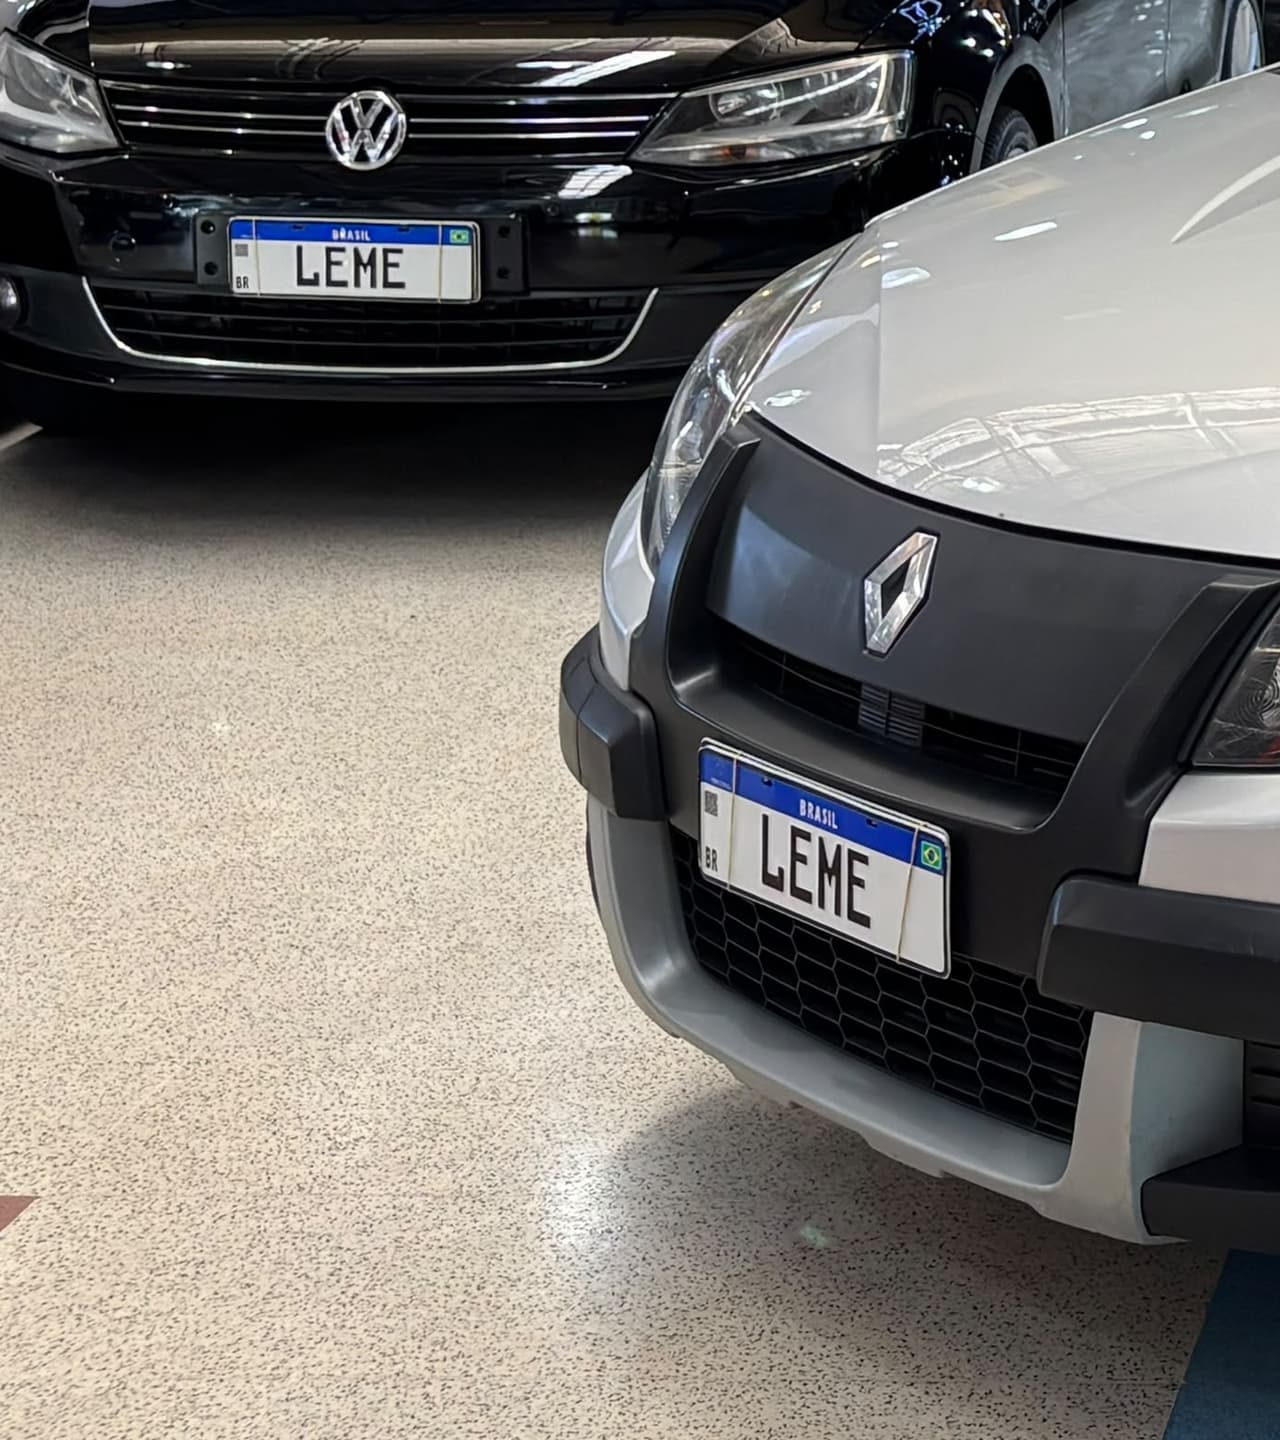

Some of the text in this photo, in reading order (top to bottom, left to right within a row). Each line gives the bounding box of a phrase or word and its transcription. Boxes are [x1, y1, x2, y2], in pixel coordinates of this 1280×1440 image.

[332, 227, 371, 242] BRASIL
[235, 275, 250, 290] BR
[296, 244, 407, 290] LEME
[799, 797, 839, 831] BRASIL
[704, 844, 719, 874] BR
[760, 812, 873, 929] LEME
